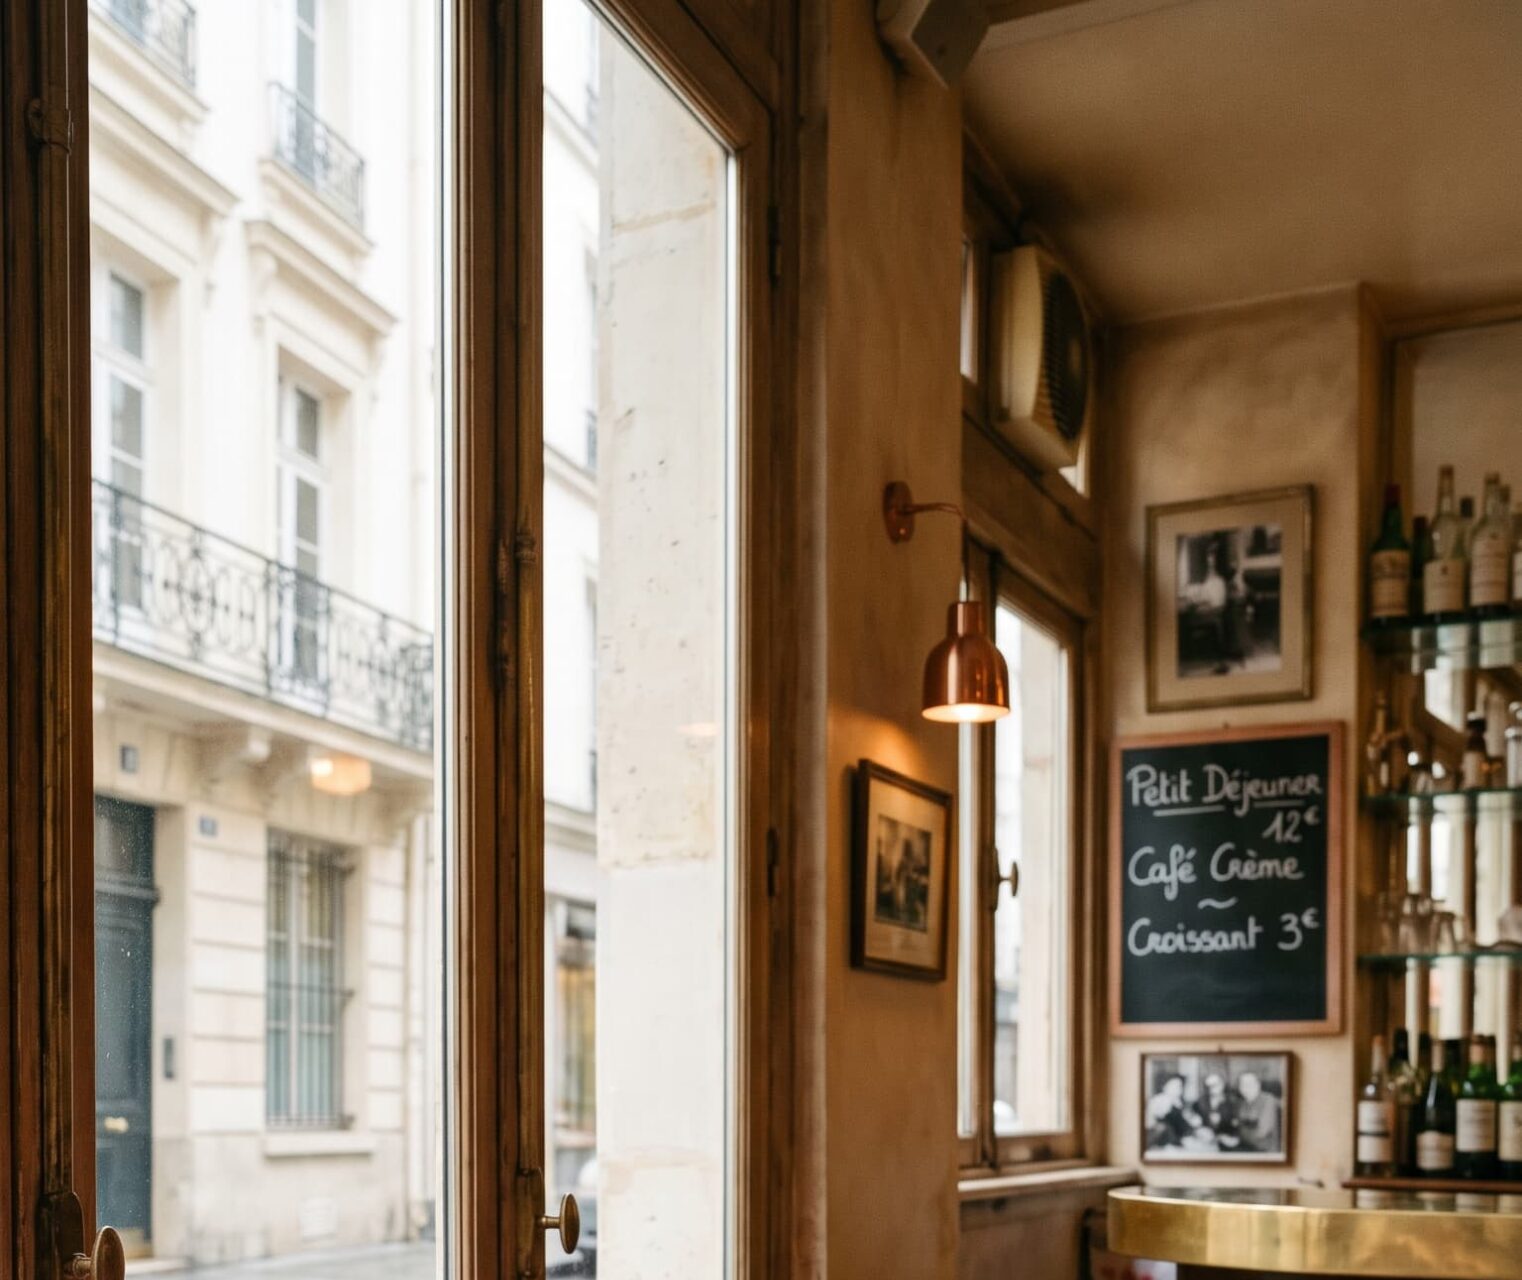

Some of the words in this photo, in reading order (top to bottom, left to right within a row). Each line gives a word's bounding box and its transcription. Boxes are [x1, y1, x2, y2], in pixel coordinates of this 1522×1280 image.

[1126, 764, 1192, 807] Petit
[1202, 764, 1323, 817] Déjeuner
[1262, 805, 1320, 843] 12€
[1127, 844, 1198, 901] Café
[1209, 842, 1304, 882] Crème
[1126, 916, 1264, 957] Croissant
[1277, 907, 1319, 951] 3€
